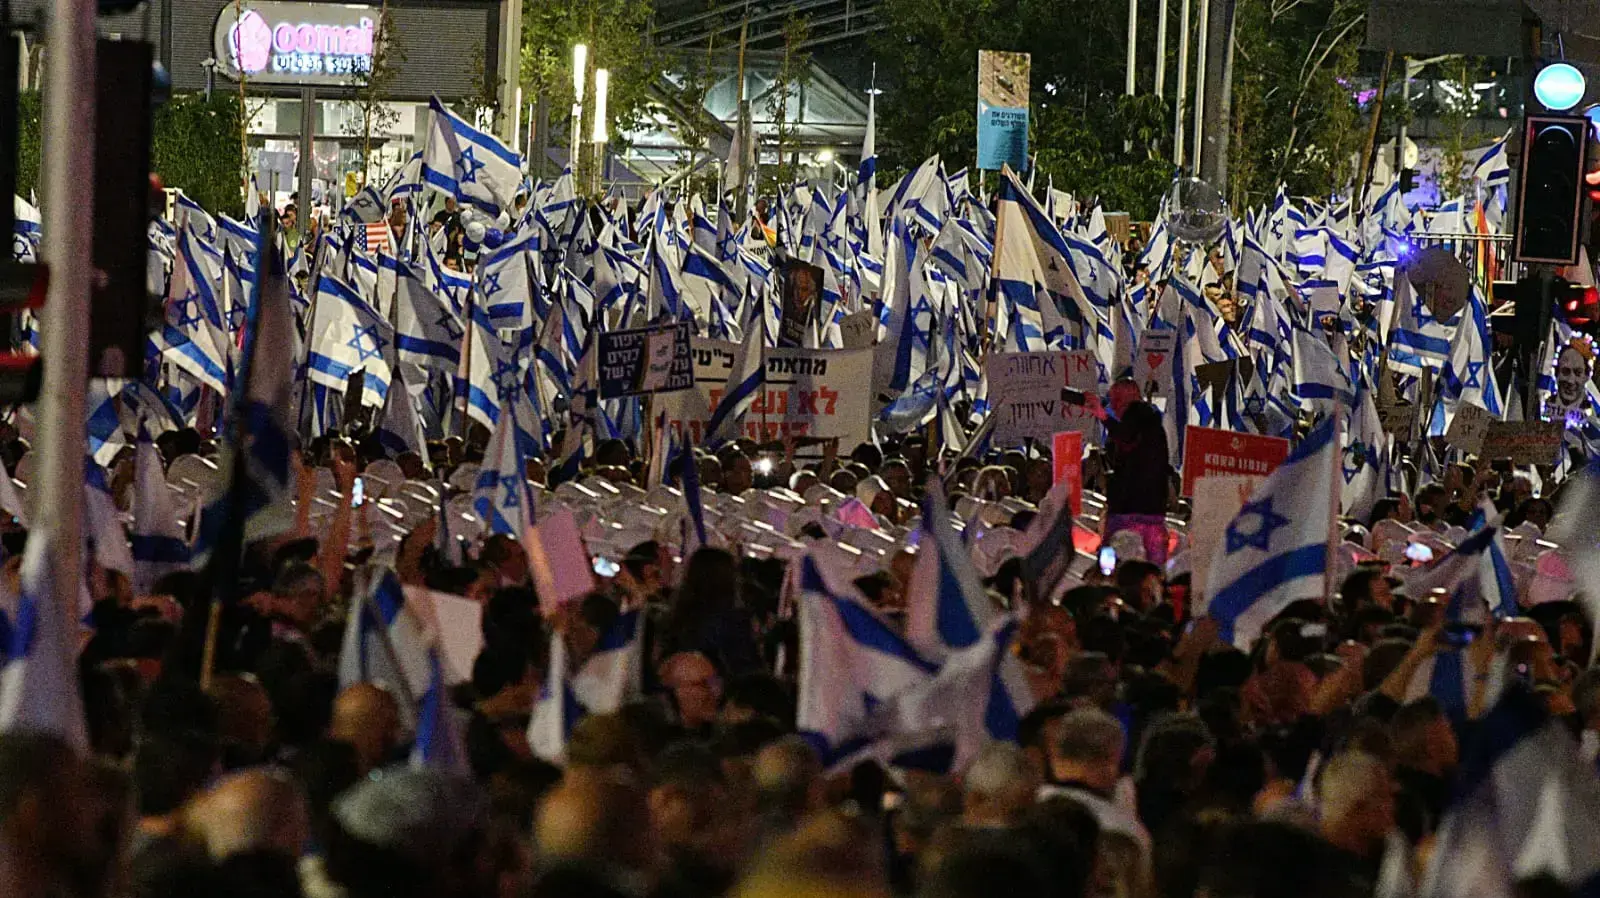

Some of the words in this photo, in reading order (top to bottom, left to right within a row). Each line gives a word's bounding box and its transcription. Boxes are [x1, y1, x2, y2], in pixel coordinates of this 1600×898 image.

[768, 357, 827, 375] מחאת
[1060, 353, 1089, 386] אין
[799, 385, 839, 415] לא
